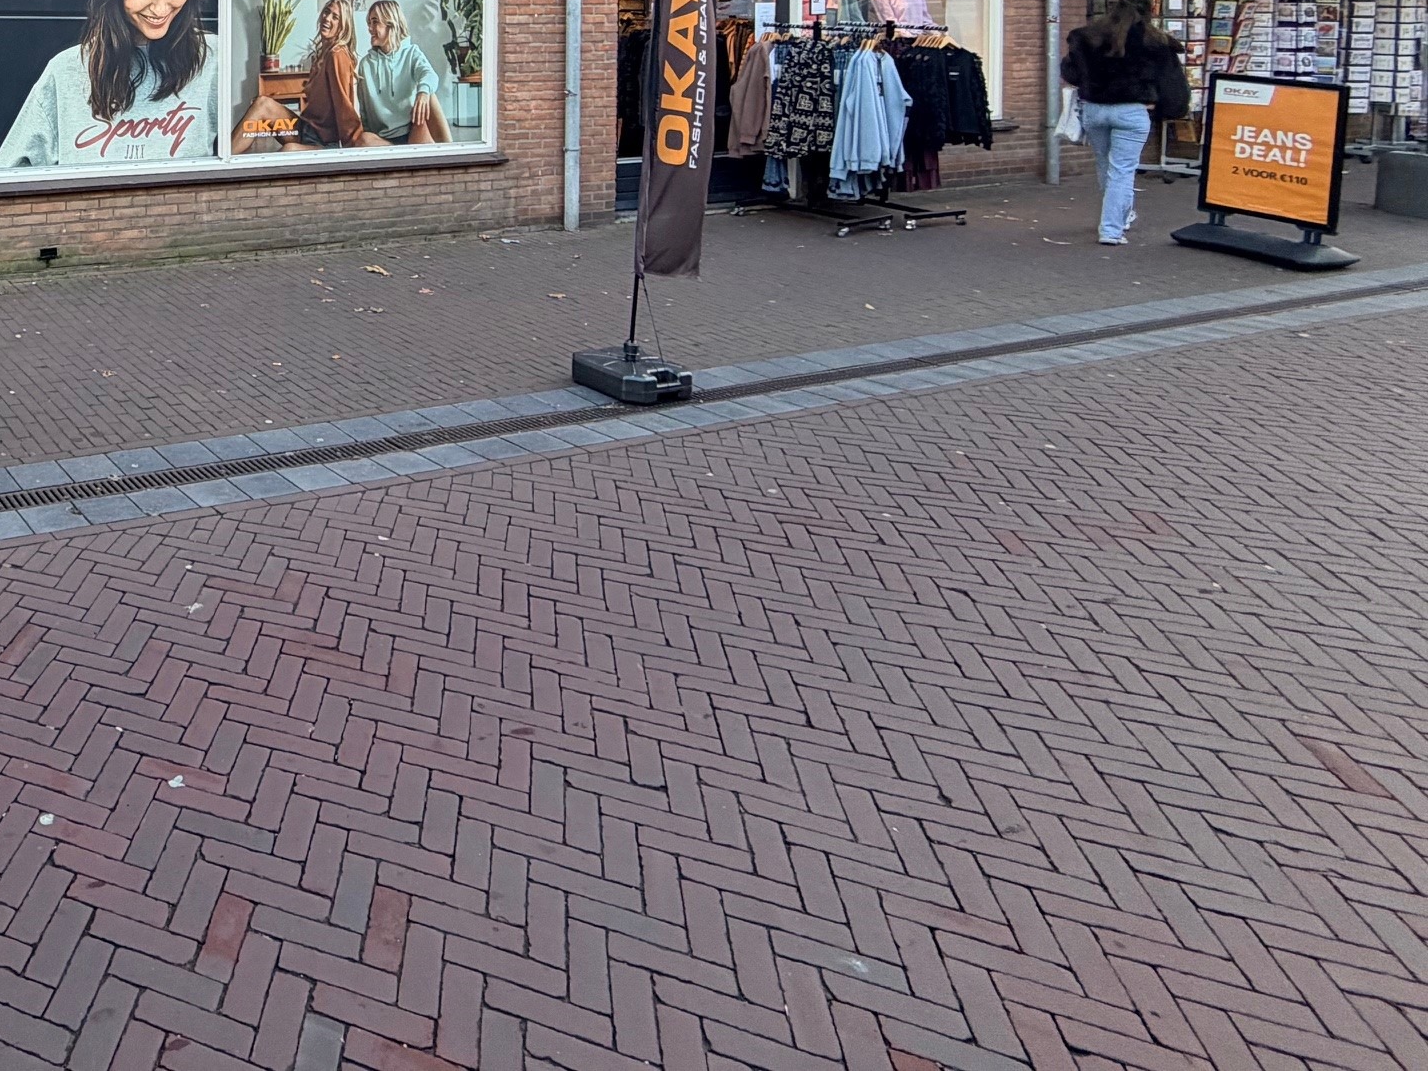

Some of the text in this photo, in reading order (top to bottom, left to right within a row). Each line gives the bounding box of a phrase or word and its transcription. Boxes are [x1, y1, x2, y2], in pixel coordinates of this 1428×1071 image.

[1223, 87, 1260, 96] OKAY
[689, 71, 707, 169] FASHION
[698, 51, 707, 65] &
[74, 101, 202, 158] Sporty
[243, 118, 299, 132] OKAY
[1231, 125, 1313, 150] JEANS
[124, 144, 146, 160] JJXX
[1234, 142, 1307, 168] DEAL!
[1232, 166, 1308, 186] 2 VOOR €110
